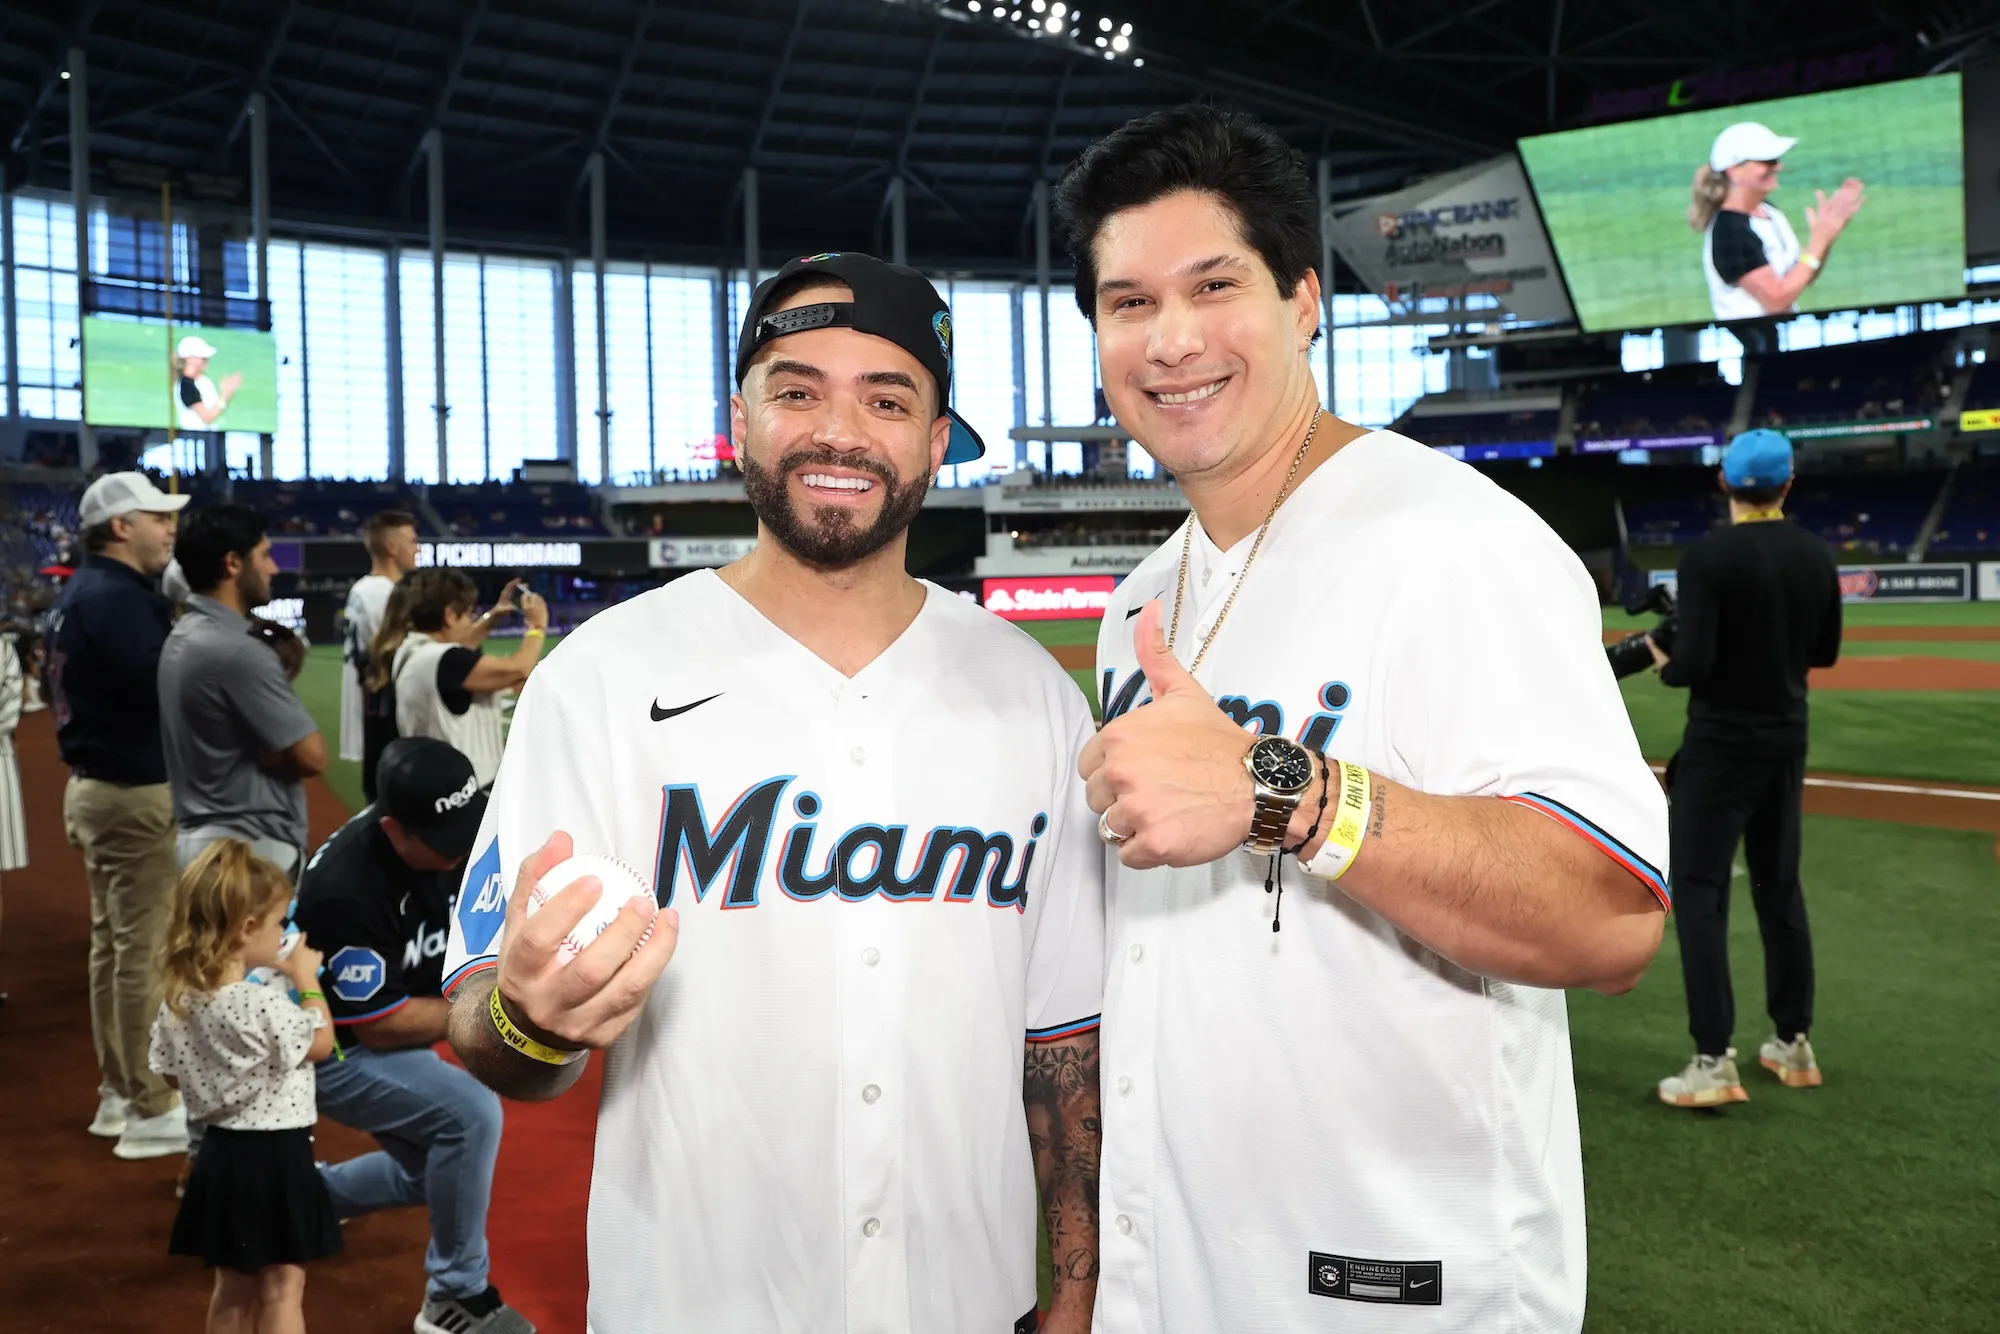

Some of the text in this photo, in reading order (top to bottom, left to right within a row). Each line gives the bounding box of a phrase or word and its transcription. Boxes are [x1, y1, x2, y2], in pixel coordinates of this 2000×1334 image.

[1345, 784, 1364, 810] FAN
[653, 774, 1049, 915] Miami
[337, 963, 377, 984] ADT
[504, 1028, 528, 1049] FAN
[1349, 1263, 1402, 1274] ENGINEERED
